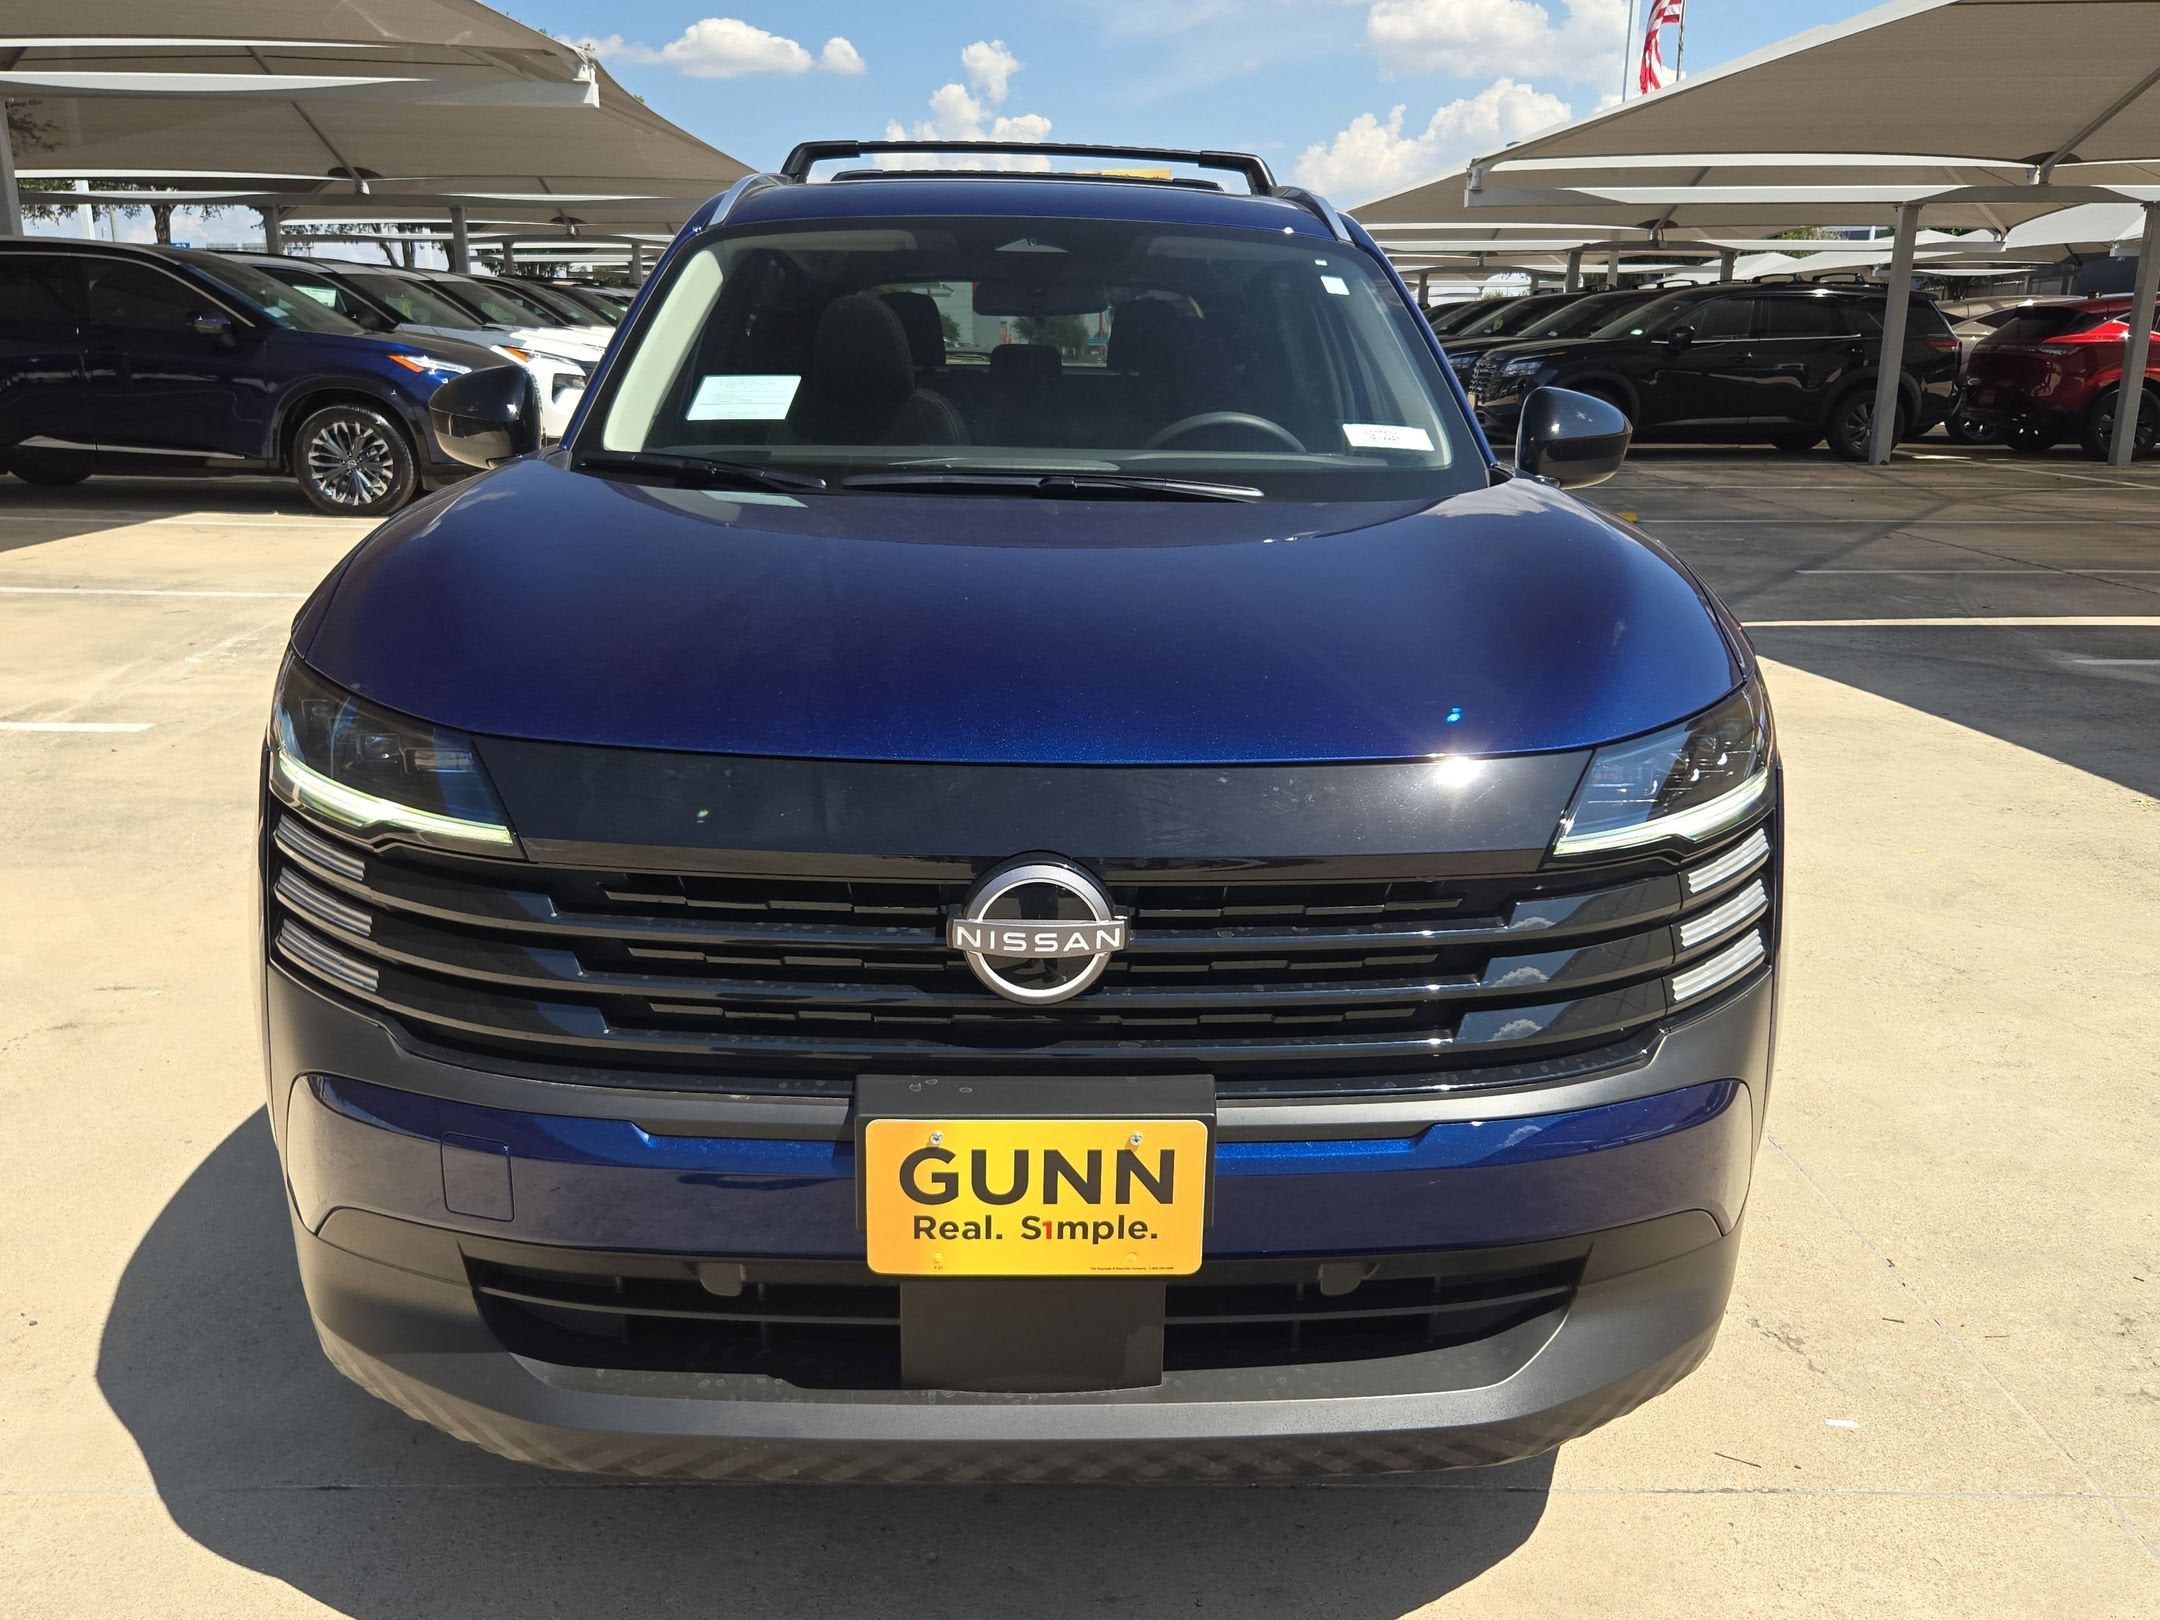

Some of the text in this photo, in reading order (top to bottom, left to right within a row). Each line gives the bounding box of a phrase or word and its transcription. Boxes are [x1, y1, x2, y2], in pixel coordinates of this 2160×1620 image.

[956, 926, 1120, 952] NISSAN
[899, 1146, 1175, 1206] GUNN
[913, 1215, 1003, 1240] Real.
